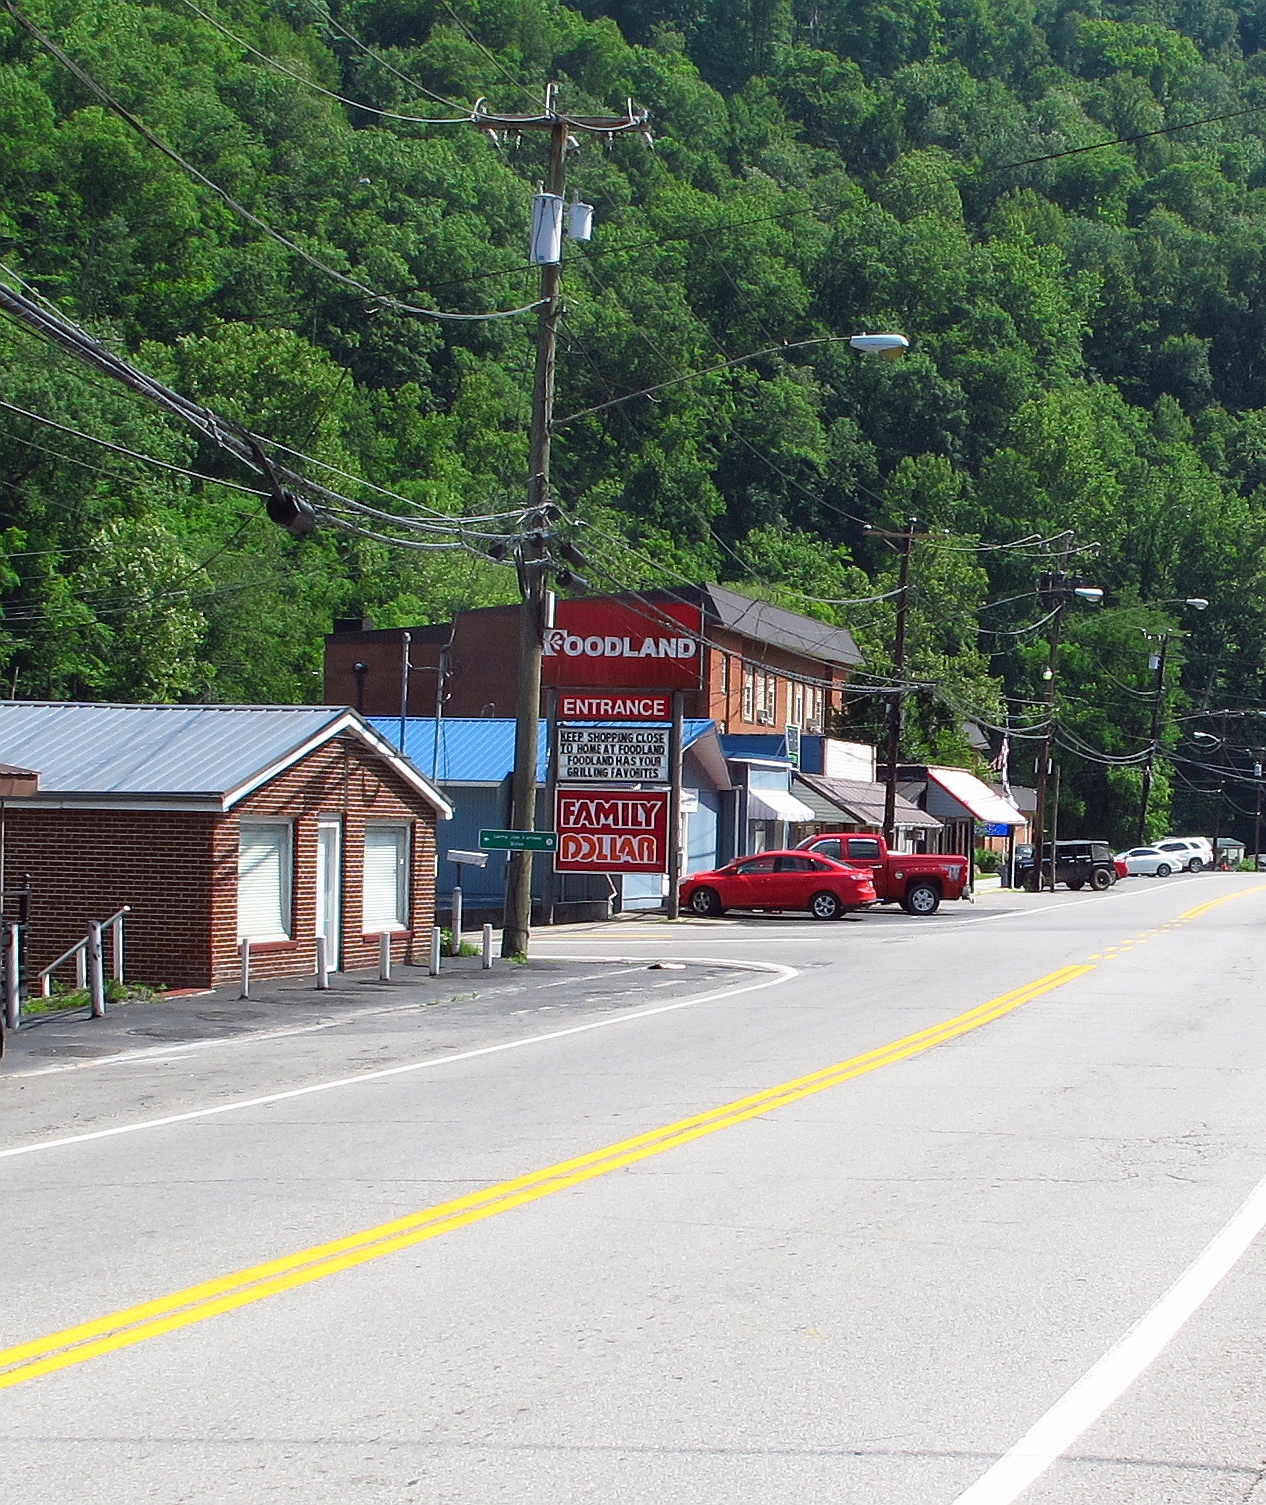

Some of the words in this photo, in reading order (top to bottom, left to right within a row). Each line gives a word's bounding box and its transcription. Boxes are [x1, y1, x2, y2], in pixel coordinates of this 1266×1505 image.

[541, 629, 697, 659] FOODLAND
[563, 698, 665, 716] ENTRANCE
[560, 731, 584, 743] KEEP
[588, 732, 634, 743] SHOPPING
[636, 732, 665, 744] CLOSE
[560, 743, 573, 754] TO
[577, 743, 601, 755] HOME
[603, 744, 616, 755] AT
[618, 744, 666, 755] FOODLAND
[567, 755, 614, 766] FOODLAND
[616, 755, 637, 766] HAS
[639, 756, 662, 767] YOUR
[567, 767, 609, 778] GRILLING
[611, 767, 659, 779] FAVORITES
[561, 799, 662, 829] FAMILY
[560, 833, 657, 864] DOLLAR
